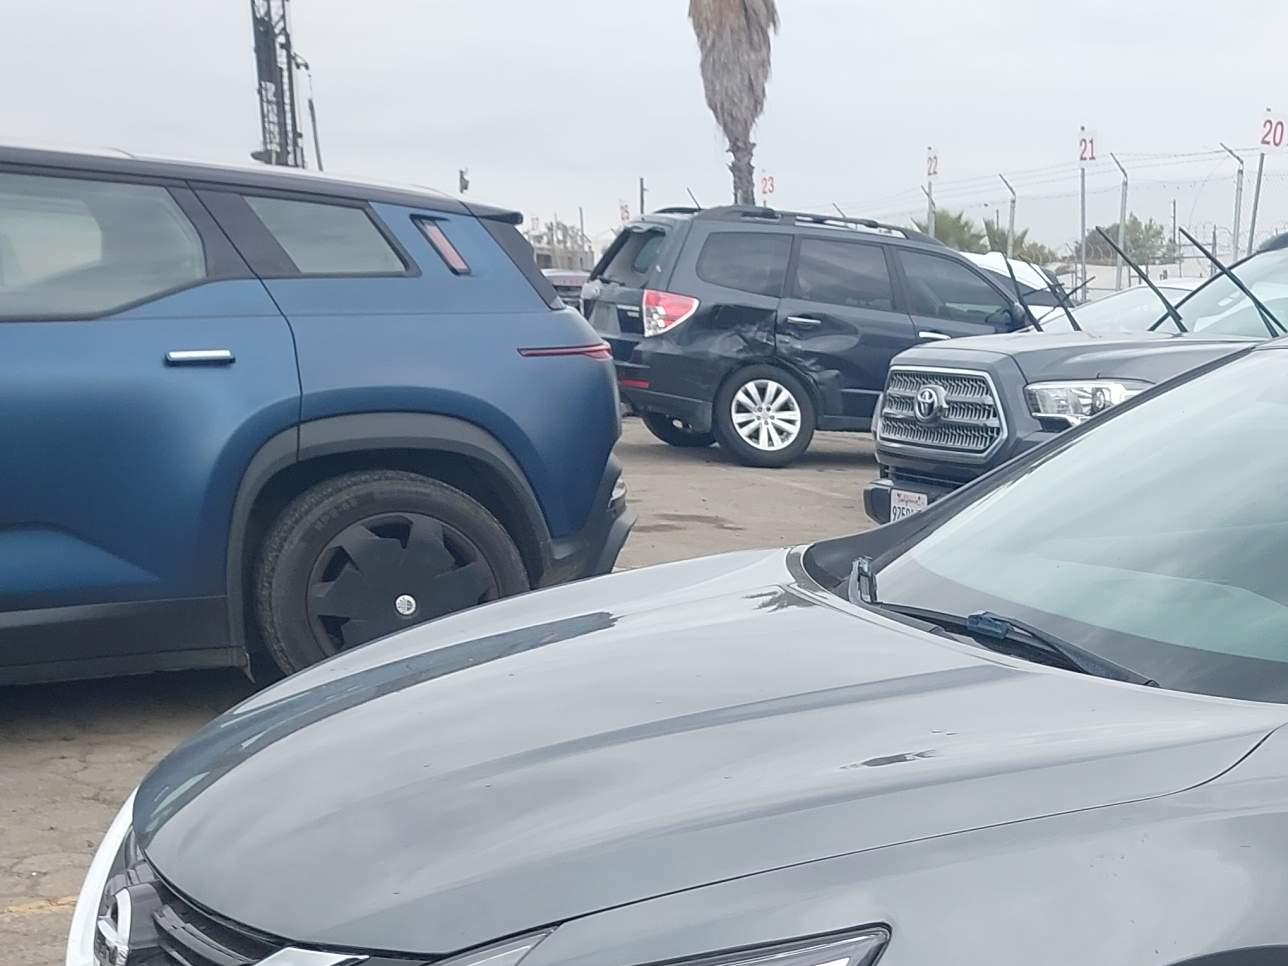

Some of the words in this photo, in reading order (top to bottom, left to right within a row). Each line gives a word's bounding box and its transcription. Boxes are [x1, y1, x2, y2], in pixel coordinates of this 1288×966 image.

[1261, 119, 1285, 147] 20
[1079, 137, 1096, 161] 21
[927, 155, 939, 176] 22
[761, 176, 775, 194] 23
